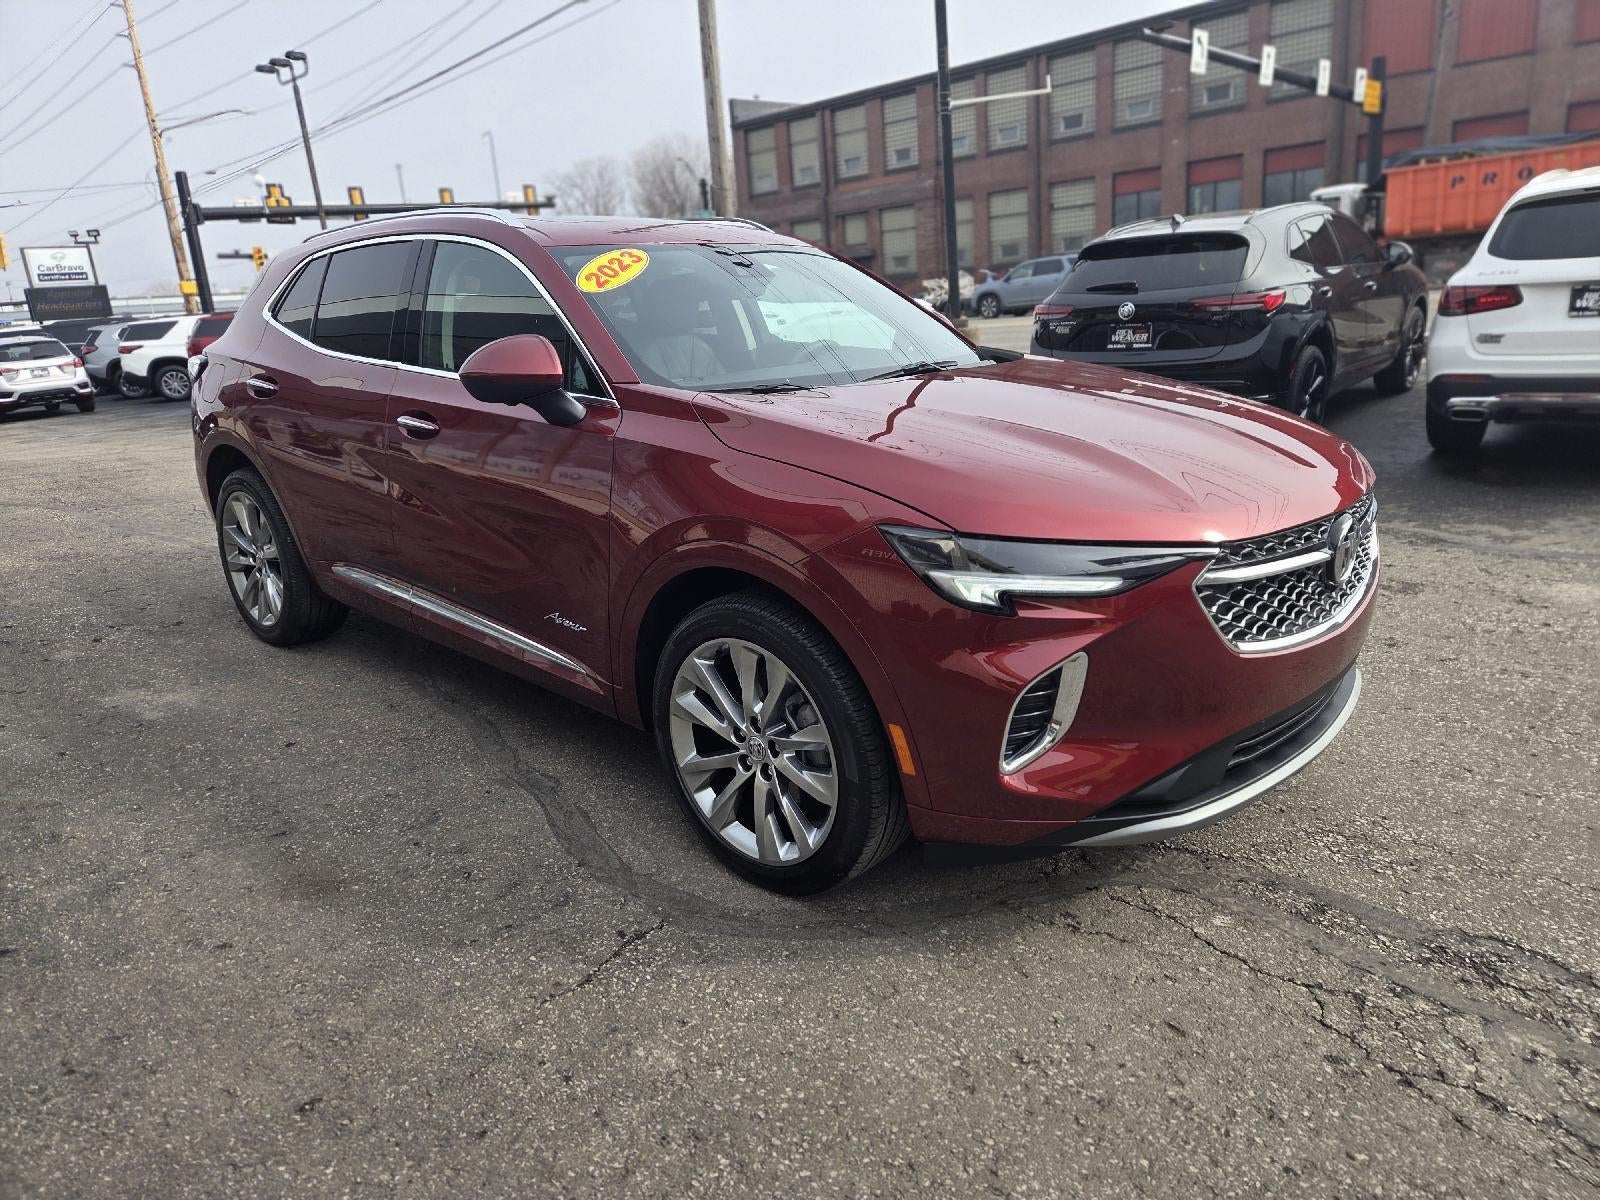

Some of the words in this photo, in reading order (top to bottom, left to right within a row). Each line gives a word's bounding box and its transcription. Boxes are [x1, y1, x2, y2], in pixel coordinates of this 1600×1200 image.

[37, 263, 85, 272] CarBravo
[585, 251, 642, 289] 2023
[1111, 333, 1149, 342] WEAVER
